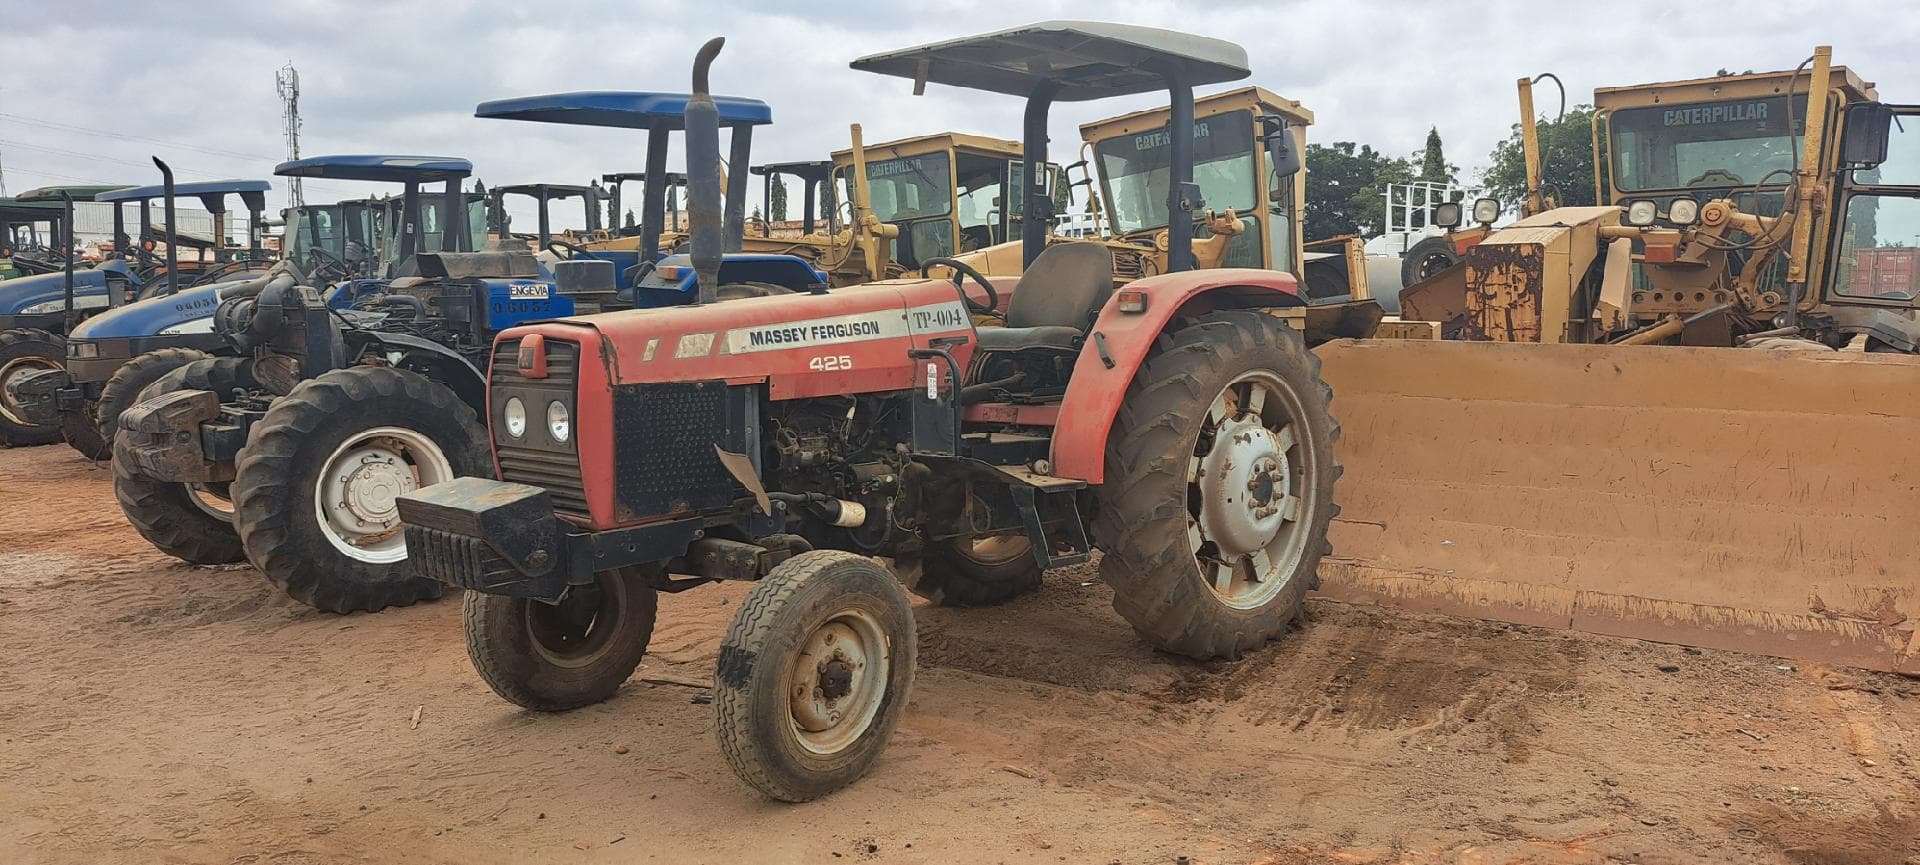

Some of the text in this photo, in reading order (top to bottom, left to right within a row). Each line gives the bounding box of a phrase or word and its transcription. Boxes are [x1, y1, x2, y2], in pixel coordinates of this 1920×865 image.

[1663, 102, 1769, 127] CATERPILLAR
[1136, 122, 1210, 151] CATERAR
[511, 285, 548, 296] ENGEVIA
[912, 308, 963, 329] TP-004
[750, 320, 881, 346] MASSEY FERGUSON
[809, 355, 853, 372] 425
